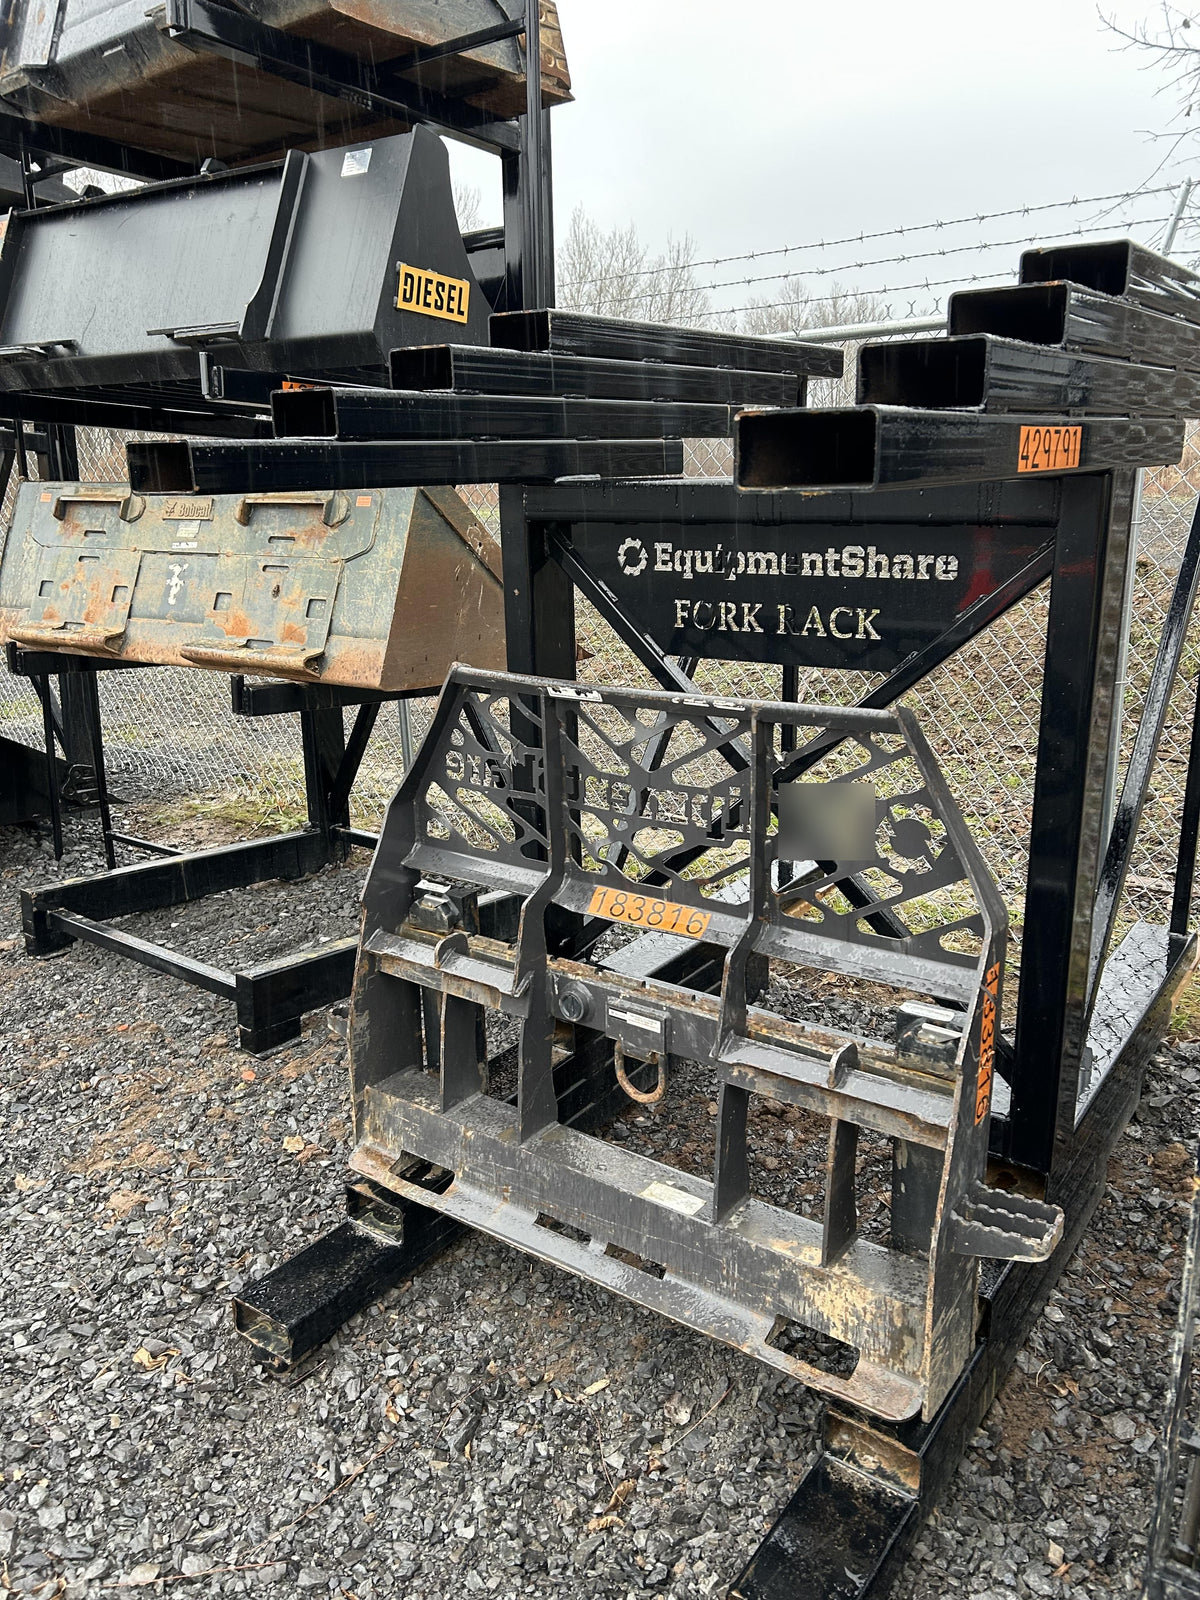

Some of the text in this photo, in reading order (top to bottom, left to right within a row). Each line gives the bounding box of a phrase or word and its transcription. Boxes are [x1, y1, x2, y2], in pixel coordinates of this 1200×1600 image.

[402, 271, 465, 317] DIESEL
[1020, 428, 1078, 469] 429791
[178, 503, 210, 517] Bobcat
[653, 542, 960, 581] EquipmentShare
[673, 598, 882, 641] FORK RACK
[596, 888, 708, 934] 183816
